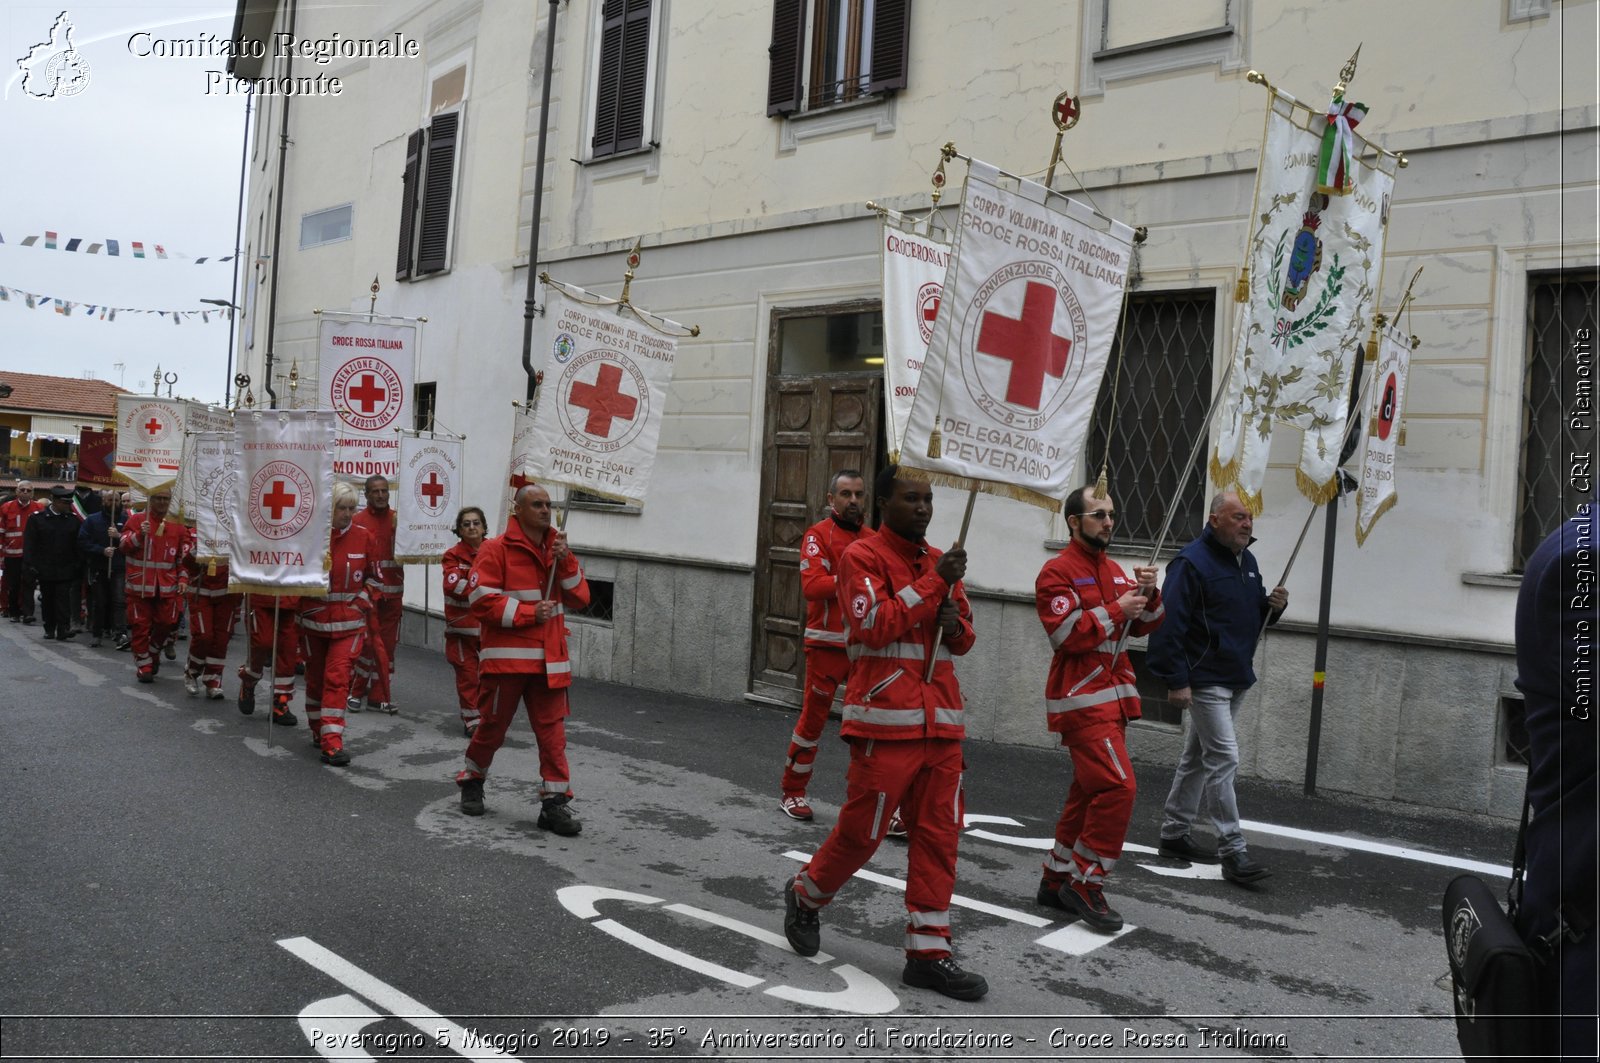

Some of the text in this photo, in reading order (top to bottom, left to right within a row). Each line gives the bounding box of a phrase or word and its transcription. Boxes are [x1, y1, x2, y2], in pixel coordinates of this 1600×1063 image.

[973, 195, 1120, 268] CORPO VOLONTARI DEL SOCCORSO
[962, 212, 1124, 289] CROCE ROSSA ITALIANA
[974, 263, 1054, 309] CONVENZIONE
[1061, 285, 1086, 344] GINEVRA
[332, 336, 402, 350] CROCE ROSSA ITALIANA
[558, 320, 592, 339] CROCE
[596, 332, 630, 350] ROSSA
[633, 344, 674, 364] ITALIANA
[564, 309, 673, 352] CORPO VOLONTARI DEL SOCCORSO
[334, 360, 400, 403] CONVENZIONE DI GINEVRA
[564, 352, 619, 379] CONVENZIONE
[630, 365, 648, 400] GINEVRA
[126, 408, 140, 428] CROCE
[163, 405, 183, 432] ITALIANA
[351, 416, 377, 428] AGOSTO
[134, 448, 162, 456] GRUPPO
[266, 442, 288, 450] ROSSA
[290, 442, 327, 452] ITALIANA
[334, 438, 399, 448] COMITATO LOCALE
[364, 450, 372, 458] di
[944, 418, 1060, 460] DELEGAZIONE DI
[549, 446, 592, 464] COMITATO
[602, 460, 635, 476] LOCALE
[552, 459, 621, 486] MORETTA
[945, 438, 1051, 480] PEVERAGNO
[200, 466, 224, 497] CROCE
[250, 481, 273, 536] CONVENZIONE
[267, 464, 300, 481] GINEVRA
[296, 491, 312, 526] AGOSTO
[250, 550, 304, 566] MANTA
